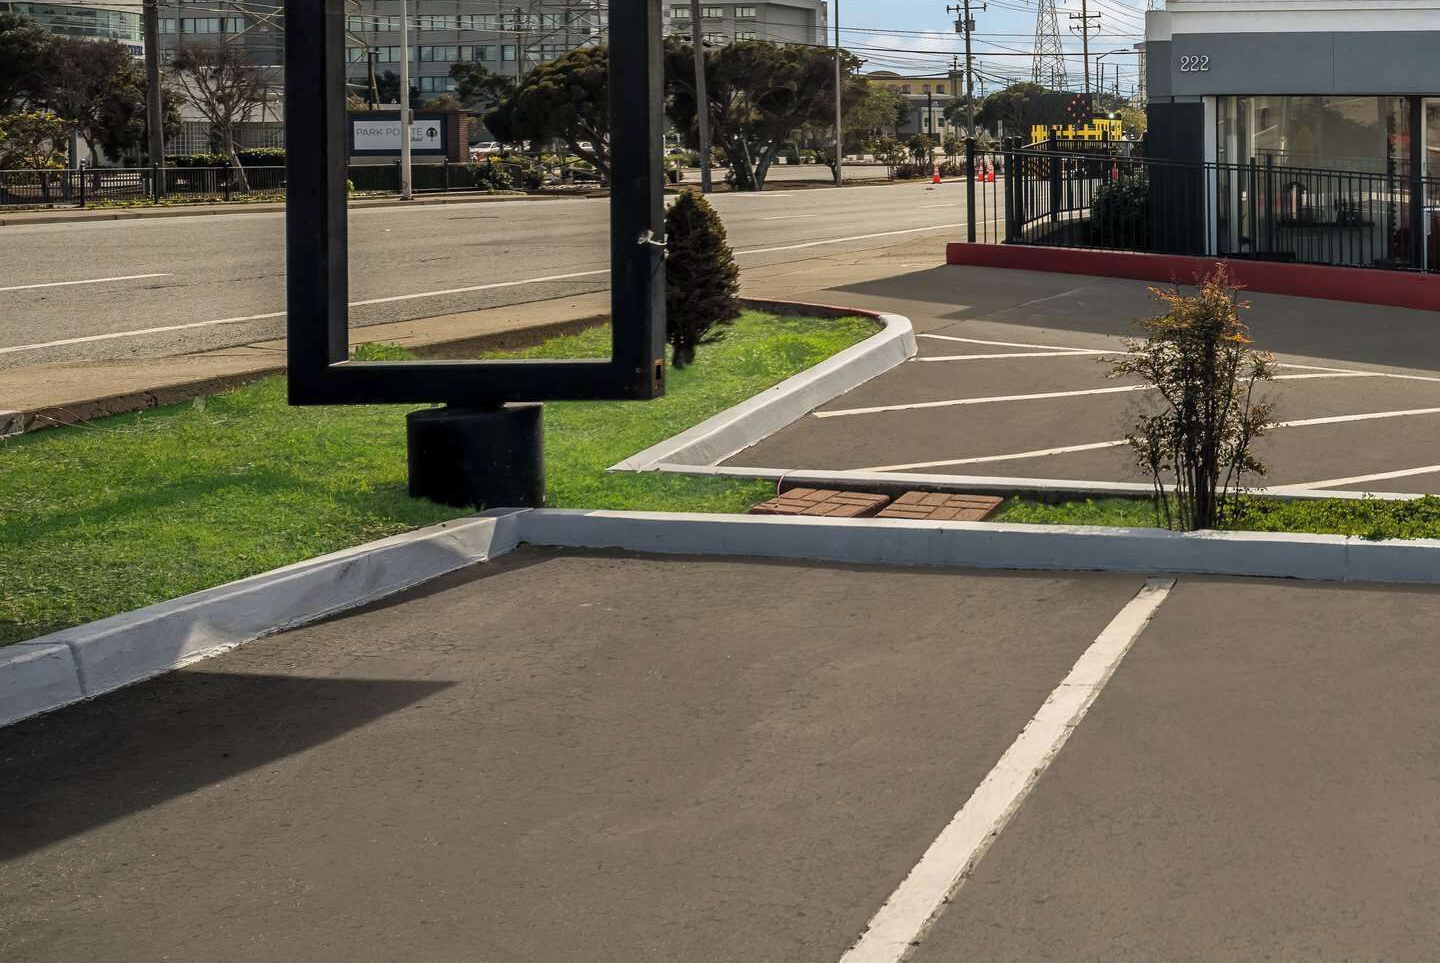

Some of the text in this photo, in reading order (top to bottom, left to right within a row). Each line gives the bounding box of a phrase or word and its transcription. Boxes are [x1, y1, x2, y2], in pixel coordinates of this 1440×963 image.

[1180, 55, 1209, 71] 222
[356, 128, 423, 136] PARK POTE
